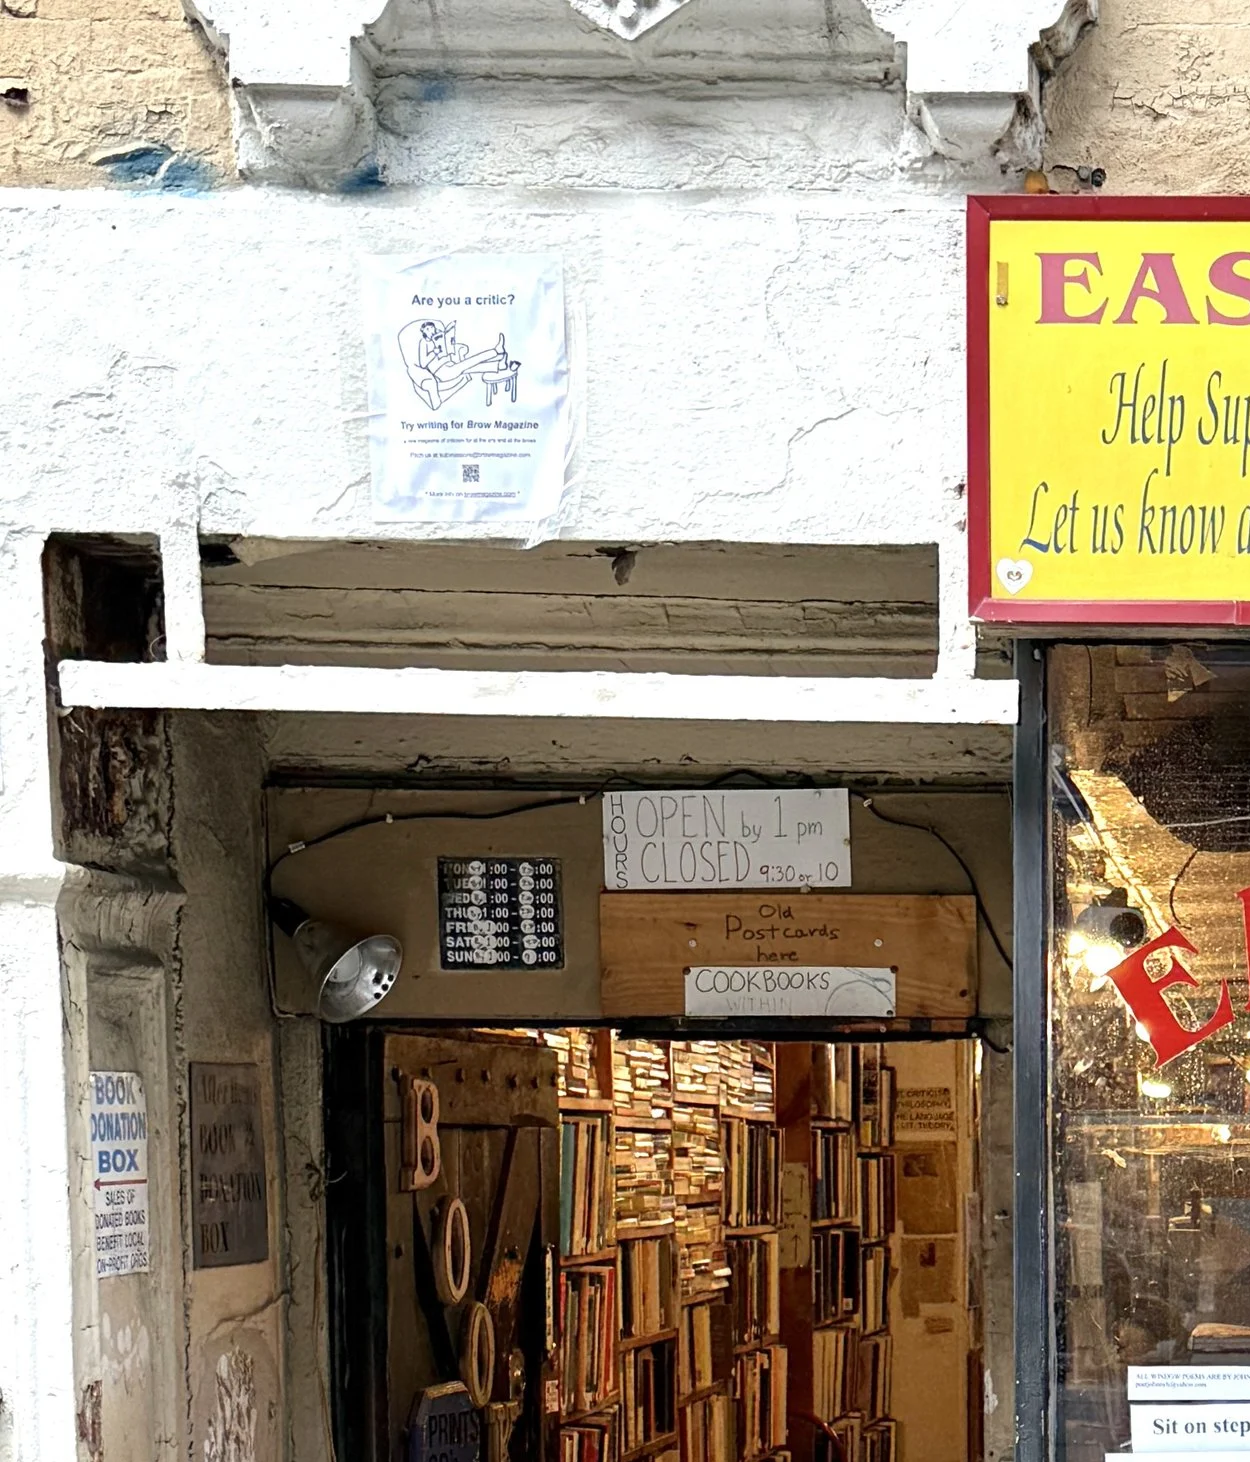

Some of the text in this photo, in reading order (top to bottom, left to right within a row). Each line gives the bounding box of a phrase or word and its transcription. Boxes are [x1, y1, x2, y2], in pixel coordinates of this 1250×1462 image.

[412, 294, 515, 308] Are you a critic?
[401, 420, 539, 432] Try writing for Brow Magazine
[1101, 359, 1186, 476] Help
[1021, 481, 1079, 554] Let
[1091, 508, 1123, 555] us
[1138, 469, 1225, 554] know
[636, 795, 823, 844] OPEN by 1 pm
[610, 795, 629, 889] HOURS
[641, 842, 839, 883] CLOSED 9:30 or 10
[759, 904, 794, 919] Old
[725, 914, 840, 940] Postcards
[757, 946, 799, 963] here
[695, 969, 830, 993] COOKBOOKS
[726, 996, 792, 1013] WITHIN
[95, 1076, 136, 1105] BOOK
[91, 1112, 146, 1142] DONATION
[99, 1149, 139, 1173] BOX
[106, 1191, 125, 1206] SALES
[96, 1209, 145, 1230] DONATED BOOKS
[97, 1231, 144, 1251] BENEFIT LOCAL
[201, 1221, 229, 1254] BOX
[97, 1256, 129, 1274] ON-PROFIT
[428, 1410, 479, 1446] PRINTS
[1153, 1418, 1250, 1437] Sit on step
